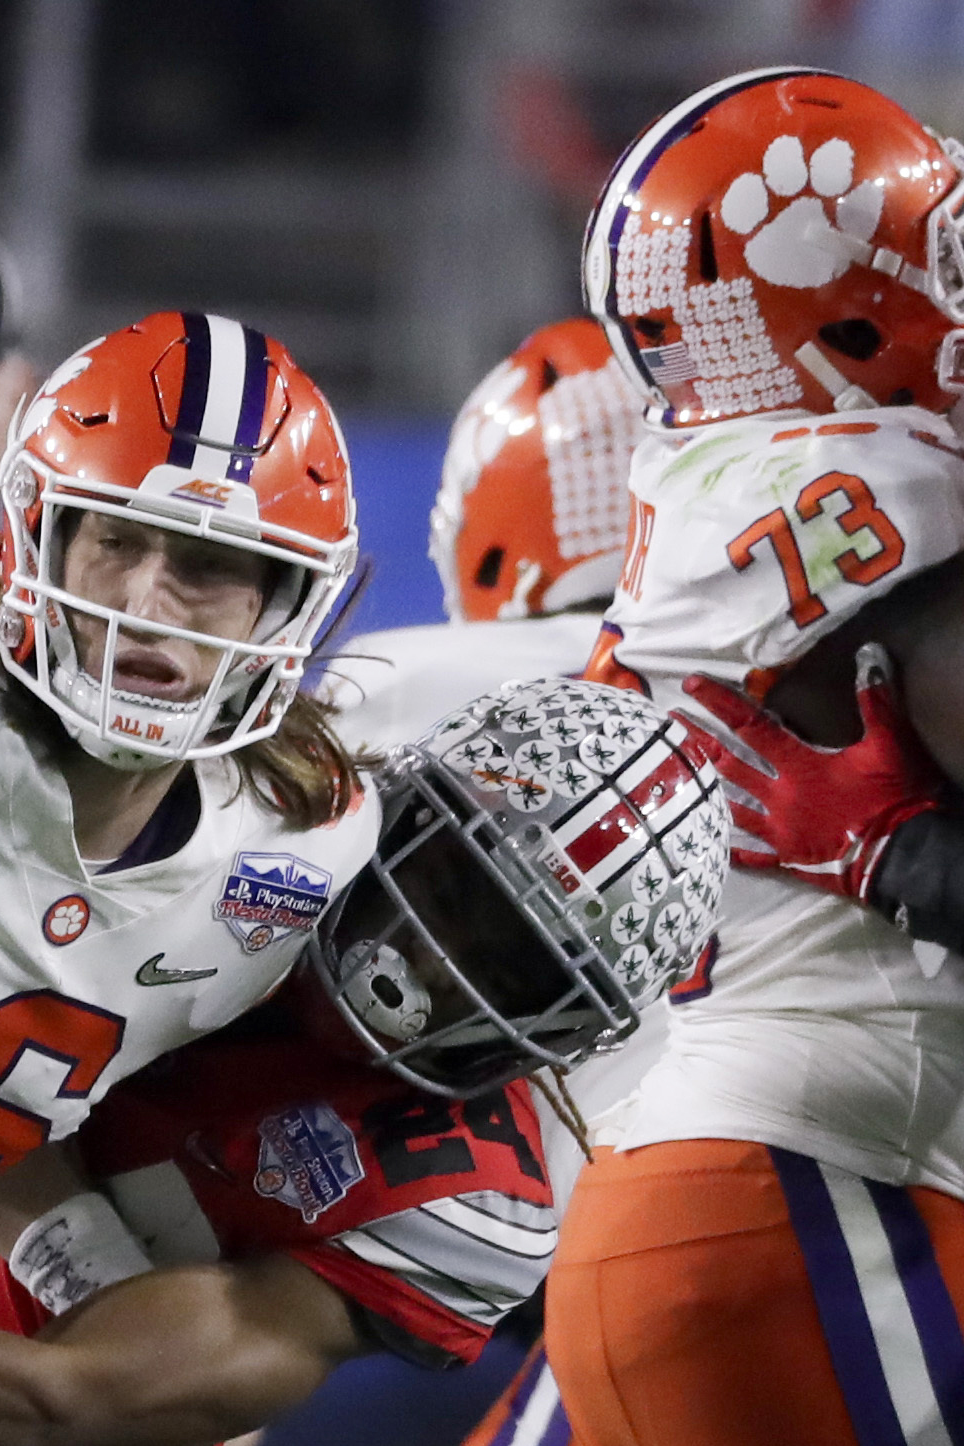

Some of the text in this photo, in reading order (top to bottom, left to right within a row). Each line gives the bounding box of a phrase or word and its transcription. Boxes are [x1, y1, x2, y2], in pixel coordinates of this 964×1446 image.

[176, 479, 234, 502] ACC
[726, 471, 905, 629] 73
[110, 715, 165, 741] ALL IN
[256, 887, 322, 913] PlayStation
